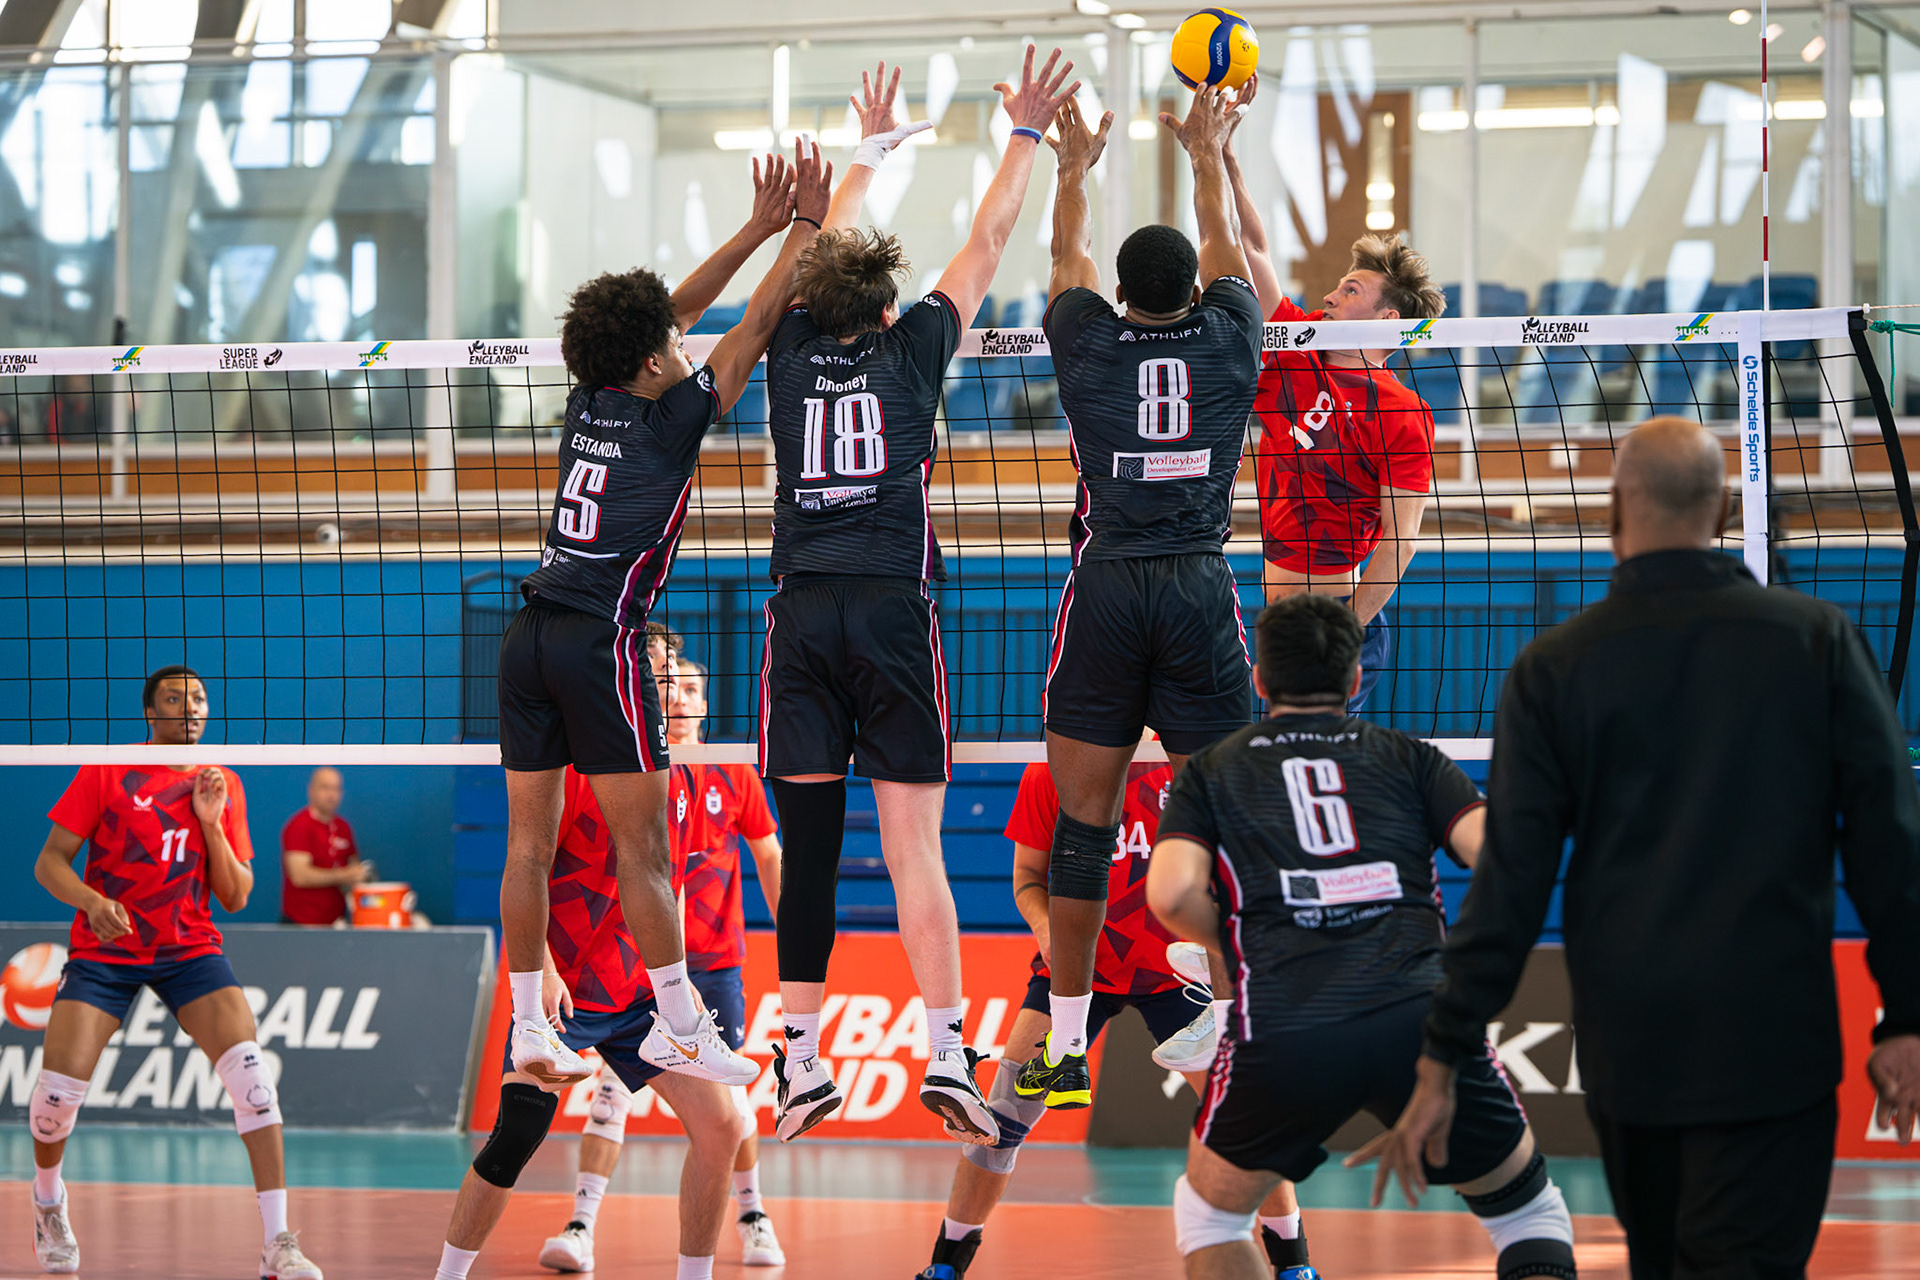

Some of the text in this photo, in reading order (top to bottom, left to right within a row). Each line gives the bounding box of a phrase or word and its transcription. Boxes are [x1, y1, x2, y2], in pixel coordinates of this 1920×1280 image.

[1521, 317, 1589, 333] VOLLEYBALL
[981, 330, 1046, 344] VOLLEYBALL
[1139, 327, 1202, 340] ATHLIFY
[1522, 333, 1575, 343] ENGLAND
[223, 347, 257, 358] SUPER
[468, 340, 530, 355] VOLLEYBALL
[981, 344, 1032, 355] ENGLAND
[219, 358, 259, 369] LEAGUE
[469, 355, 517, 365] ENGLAND
[1138, 358, 1192, 443] 8
[1745, 371, 1761, 482] Schelde Sports
[800, 393, 889, 481] 18
[1148, 453, 1207, 467] Volleyball
[1147, 466, 1187, 474] Development
[557, 459, 609, 543] 5
[658, 724, 667, 747] 5
[1274, 731, 1360, 745] ATHLIFY
[1281, 756, 1360, 859] 6
[161, 828, 190, 863] 11
